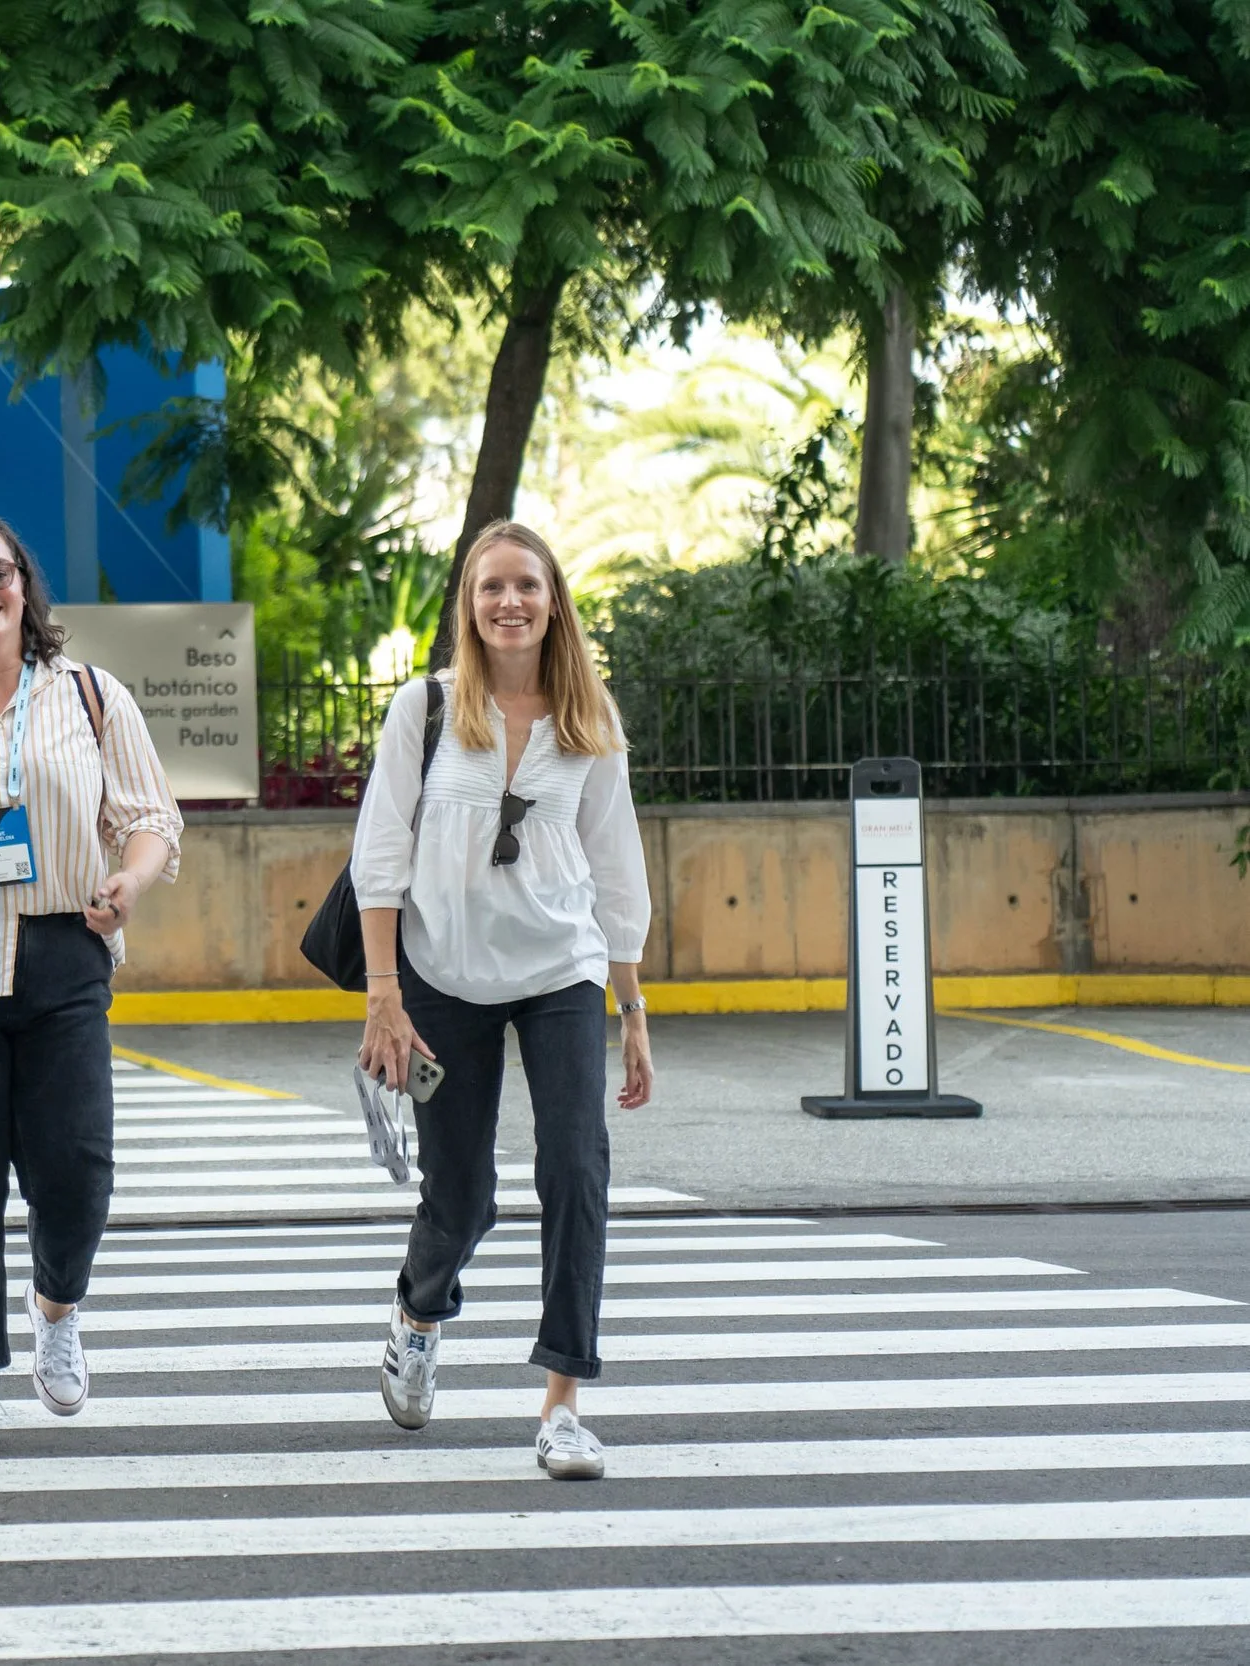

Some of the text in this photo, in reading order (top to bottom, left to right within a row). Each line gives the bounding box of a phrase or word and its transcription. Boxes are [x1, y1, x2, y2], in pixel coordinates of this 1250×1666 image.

[185, 647, 237, 667] Beso
[143, 676, 238, 698] botánico
[181, 702, 239, 721] garden
[179, 726, 239, 748] Palau
[883, 871, 904, 1086] RESERVADO
